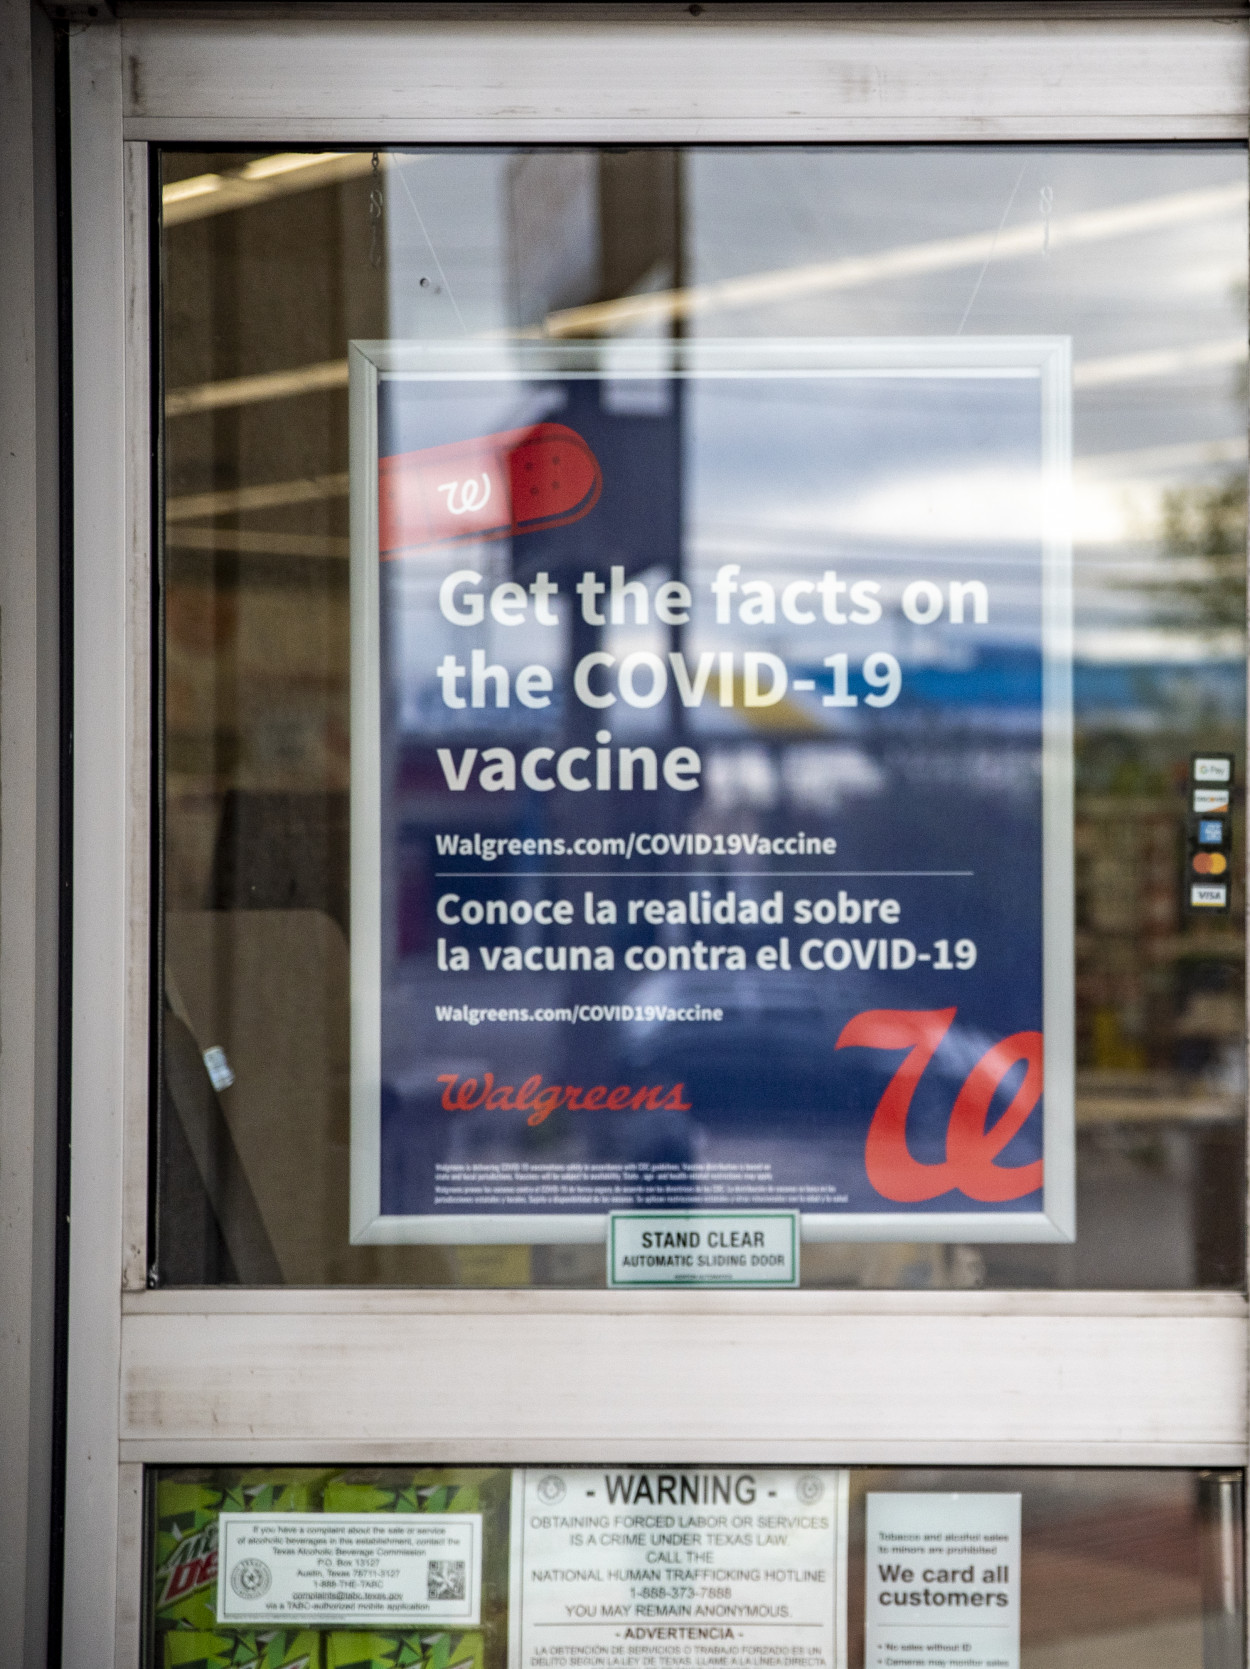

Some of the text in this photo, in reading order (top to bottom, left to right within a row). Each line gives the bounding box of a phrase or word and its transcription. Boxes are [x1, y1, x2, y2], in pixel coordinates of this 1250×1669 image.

[438, 564, 989, 625] Get the facts on
[437, 649, 902, 710] the COVID-19
[437, 731, 702, 792] vaccine
[435, 832, 837, 861] Walgreens.com/COVID19Vaccine
[1198, 890, 1222, 900] VISA
[435, 891, 901, 925] Conoce la realidad sobre
[437, 938, 977, 971] la vacuna contra el COVID-19
[435, 1004, 723, 1025] Walgreens.com/COVID19Vaccine
[437, 1073, 692, 1126] Walgreens
[642, 1232, 765, 1248] STAND CLEAR
[623, 1255, 785, 1266] AUTOMATIC SLIDING DOOR
[605, 1475, 756, 1505] WARNING
[530, 1516, 829, 1529] OBTAINING FORCED LABOR OR SERVICES
[570, 1534, 583, 1546] IS
[587, 1534, 597, 1546] A
[600, 1534, 647, 1546] CRIME
[651, 1534, 702, 1546] UNDER
[707, 1534, 751, 1546] TEXAS
[924, 1533, 942, 1541] and
[945, 1533, 980, 1541] alcohol
[983, 1533, 1009, 1541] sales
[273, 1547, 426, 1557] Texas Alcoholic Beverage Commission
[878, 1546, 889, 1554] to
[892, 1546, 925, 1554] minors
[947, 1546, 997, 1555] prohibited
[337, 1558, 352, 1566] Box
[646, 1552, 714, 1564] CALL THE
[327, 1569, 350, 1577] Texas
[531, 1570, 826, 1582] NATIONAL HUMAN TRAFFICKING HOTLINE
[878, 1565, 1009, 1583] We card all
[630, 1587, 732, 1599] 1-888-373-7888
[879, 1589, 1009, 1607] customers
[565, 1605, 597, 1617] YOU
[601, 1605, 631, 1617] MAY
[636, 1605, 691, 1617] REMAIN
[624, 1628, 734, 1639] ADVERTENCIA
